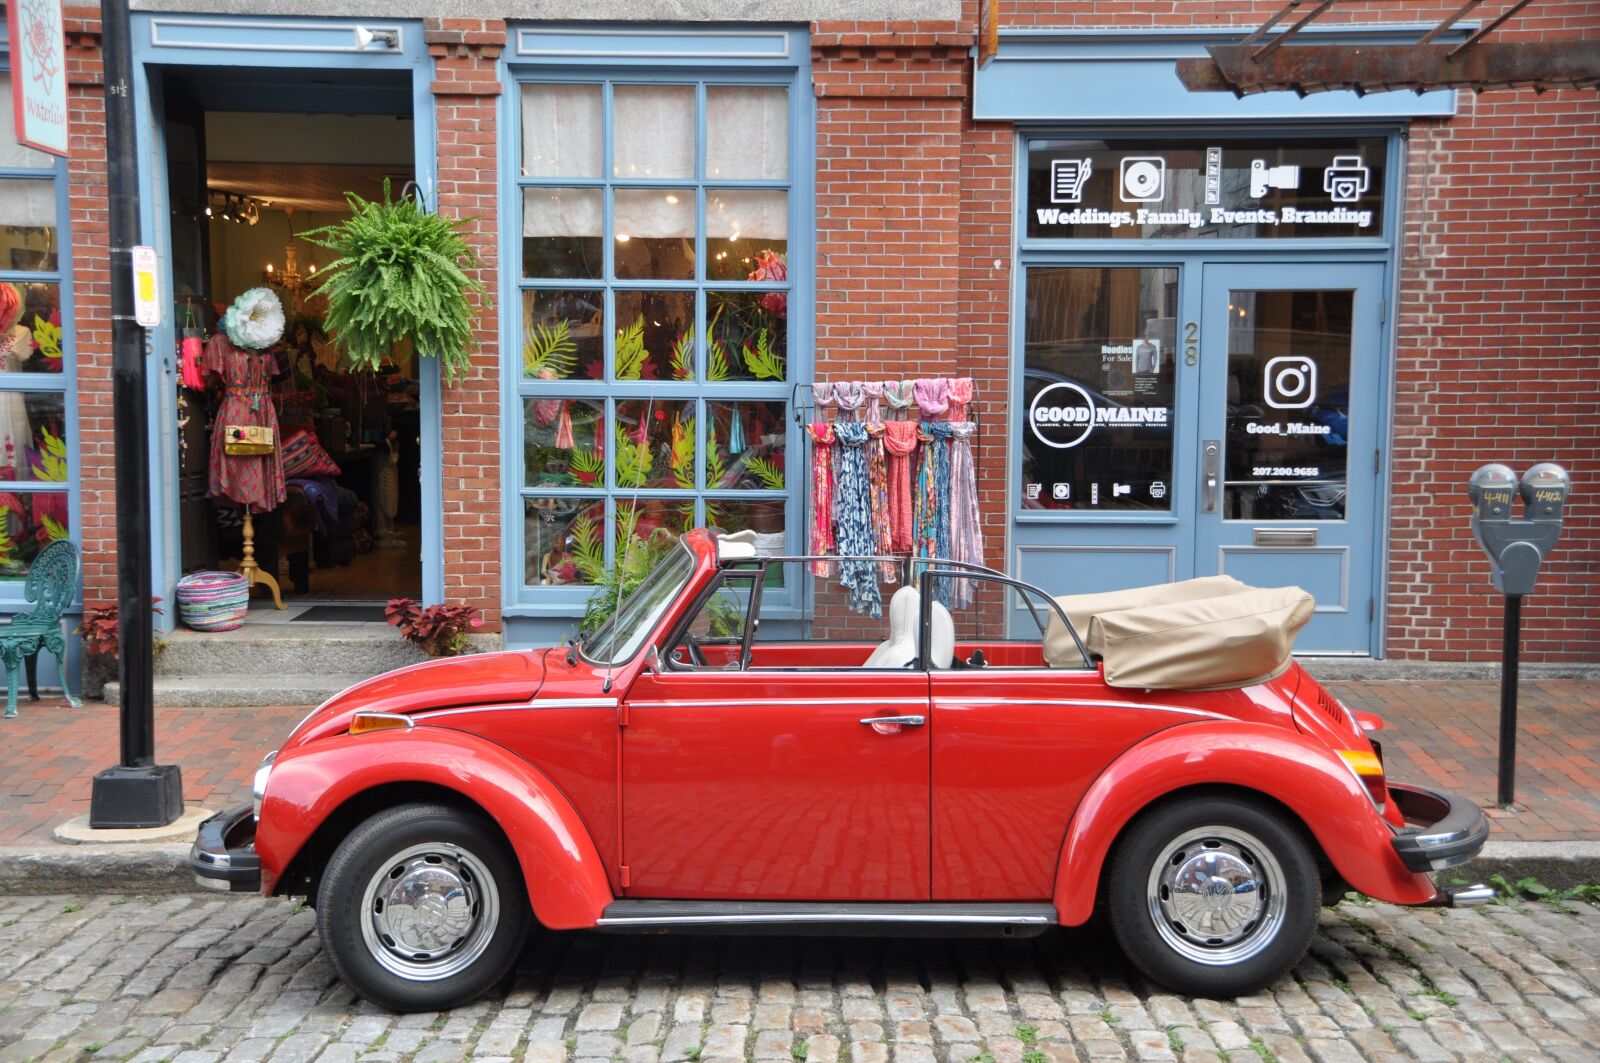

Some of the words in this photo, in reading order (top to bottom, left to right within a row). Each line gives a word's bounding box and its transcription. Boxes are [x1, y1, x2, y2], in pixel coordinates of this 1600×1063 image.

[1037, 208, 1134, 228] Weddings,
[1136, 208, 1205, 228] Family,
[1210, 207, 1279, 226] Events,
[1281, 207, 1371, 227] Branding
[1101, 345, 1133, 354] Hoodies
[1035, 407, 1090, 422] GOOD
[1096, 407, 1167, 422] MAINE
[1246, 422, 1331, 436] Good_Maine
[1252, 467, 1319, 476] 207.200.9655
